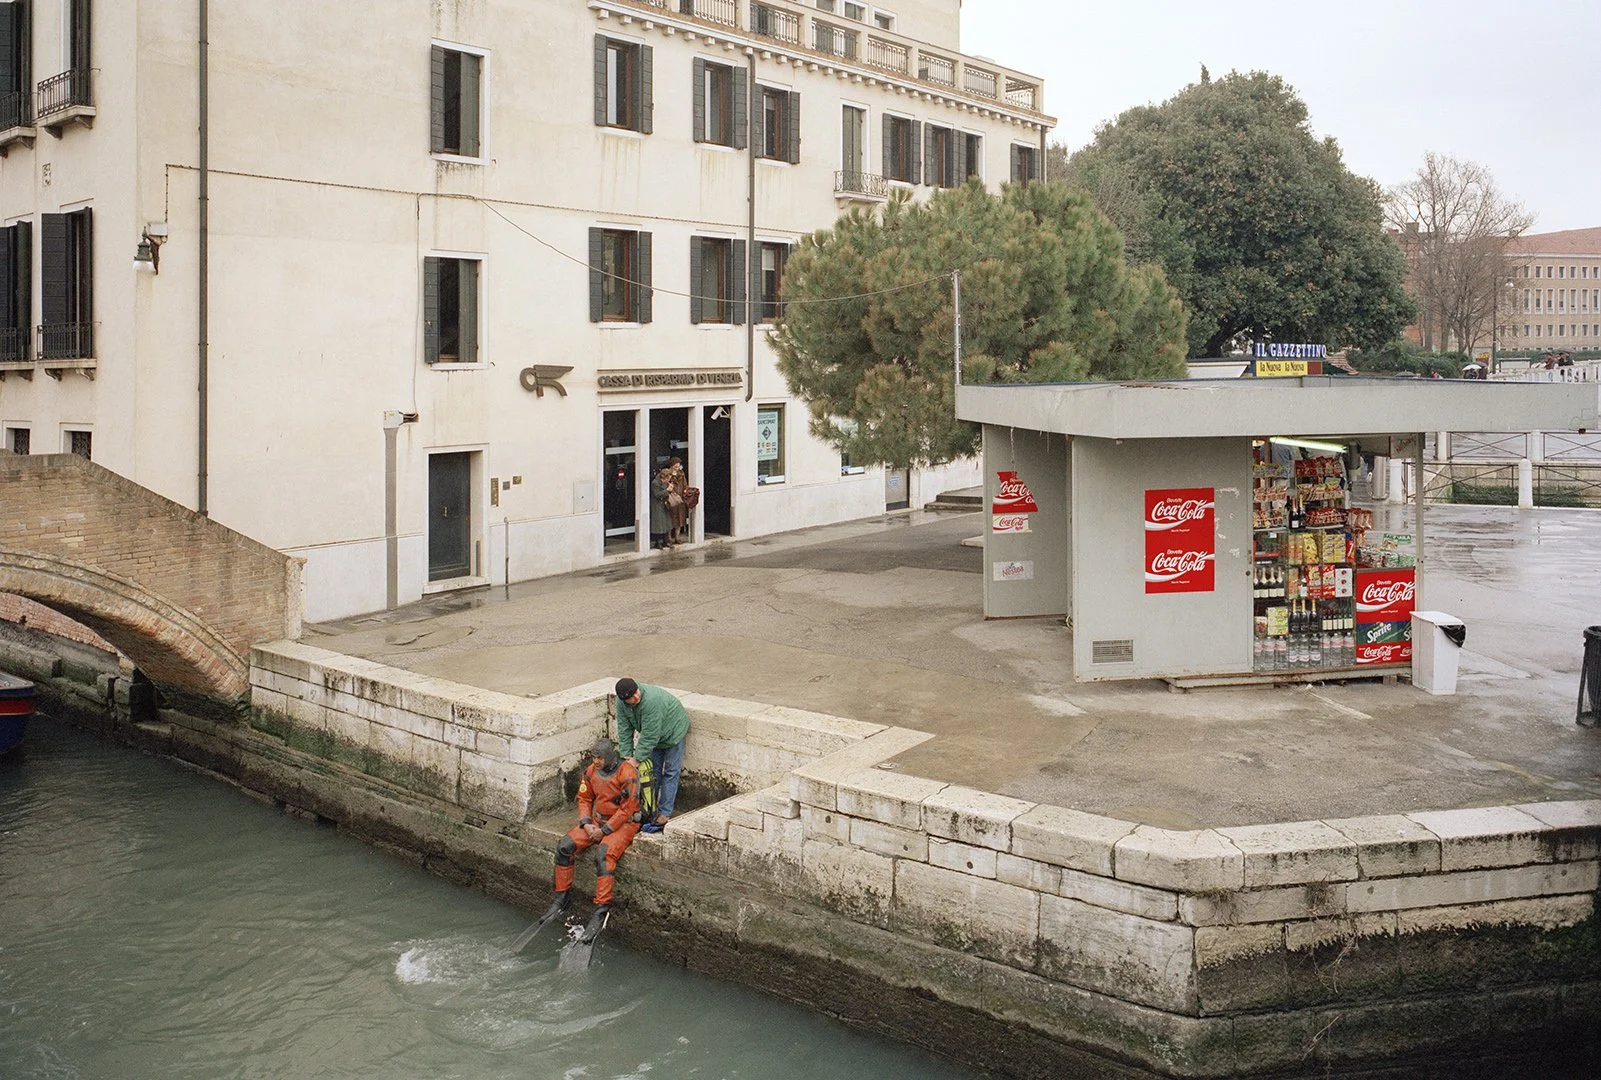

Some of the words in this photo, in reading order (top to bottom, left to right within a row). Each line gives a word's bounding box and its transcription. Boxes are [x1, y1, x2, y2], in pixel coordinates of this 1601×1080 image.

[1256, 343, 1267, 358] IL
[1270, 343, 1327, 358] GAZZETTINO
[597, 375, 631, 388] CASSA
[631, 375, 643, 387] DI
[644, 374, 695, 388] RISPARMIO
[696, 373, 706, 385] DI
[707, 372, 742, 385] VENEZIA
[1366, 623, 1392, 644] Sprite
